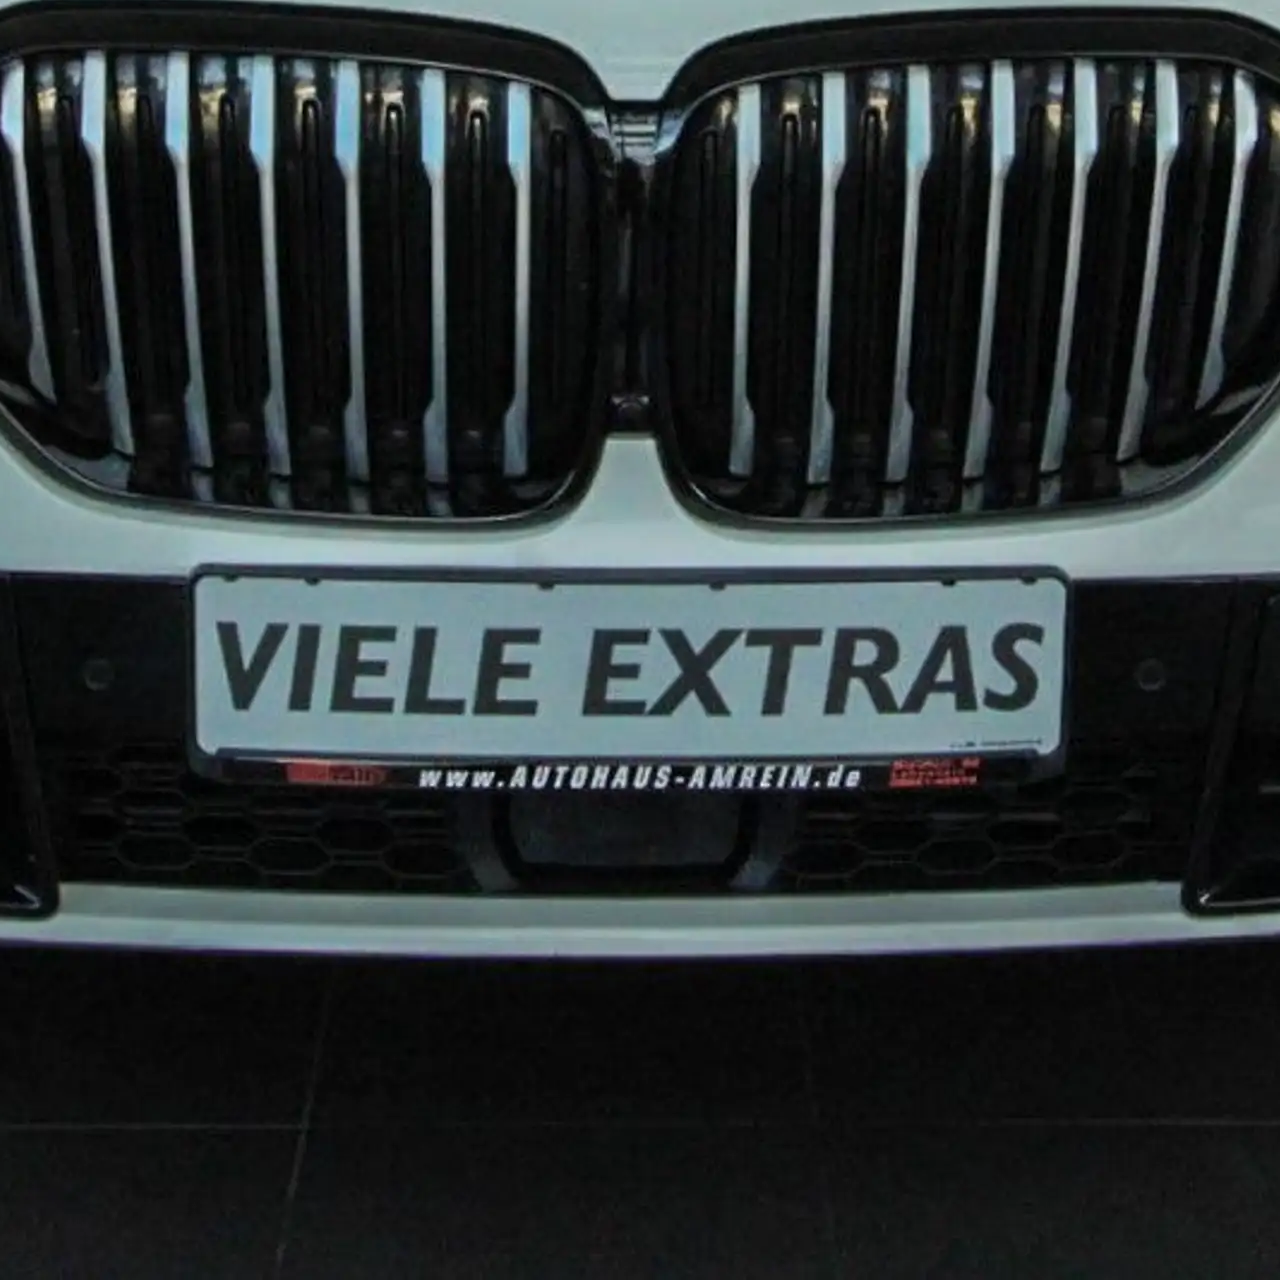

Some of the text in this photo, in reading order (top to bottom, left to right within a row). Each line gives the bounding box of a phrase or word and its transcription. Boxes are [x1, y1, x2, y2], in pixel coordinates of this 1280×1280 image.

[216, 621, 1045, 717] VIELE EXTRAS
[419, 764, 861, 790] www.AUTOHAUS-AMREIN.de
